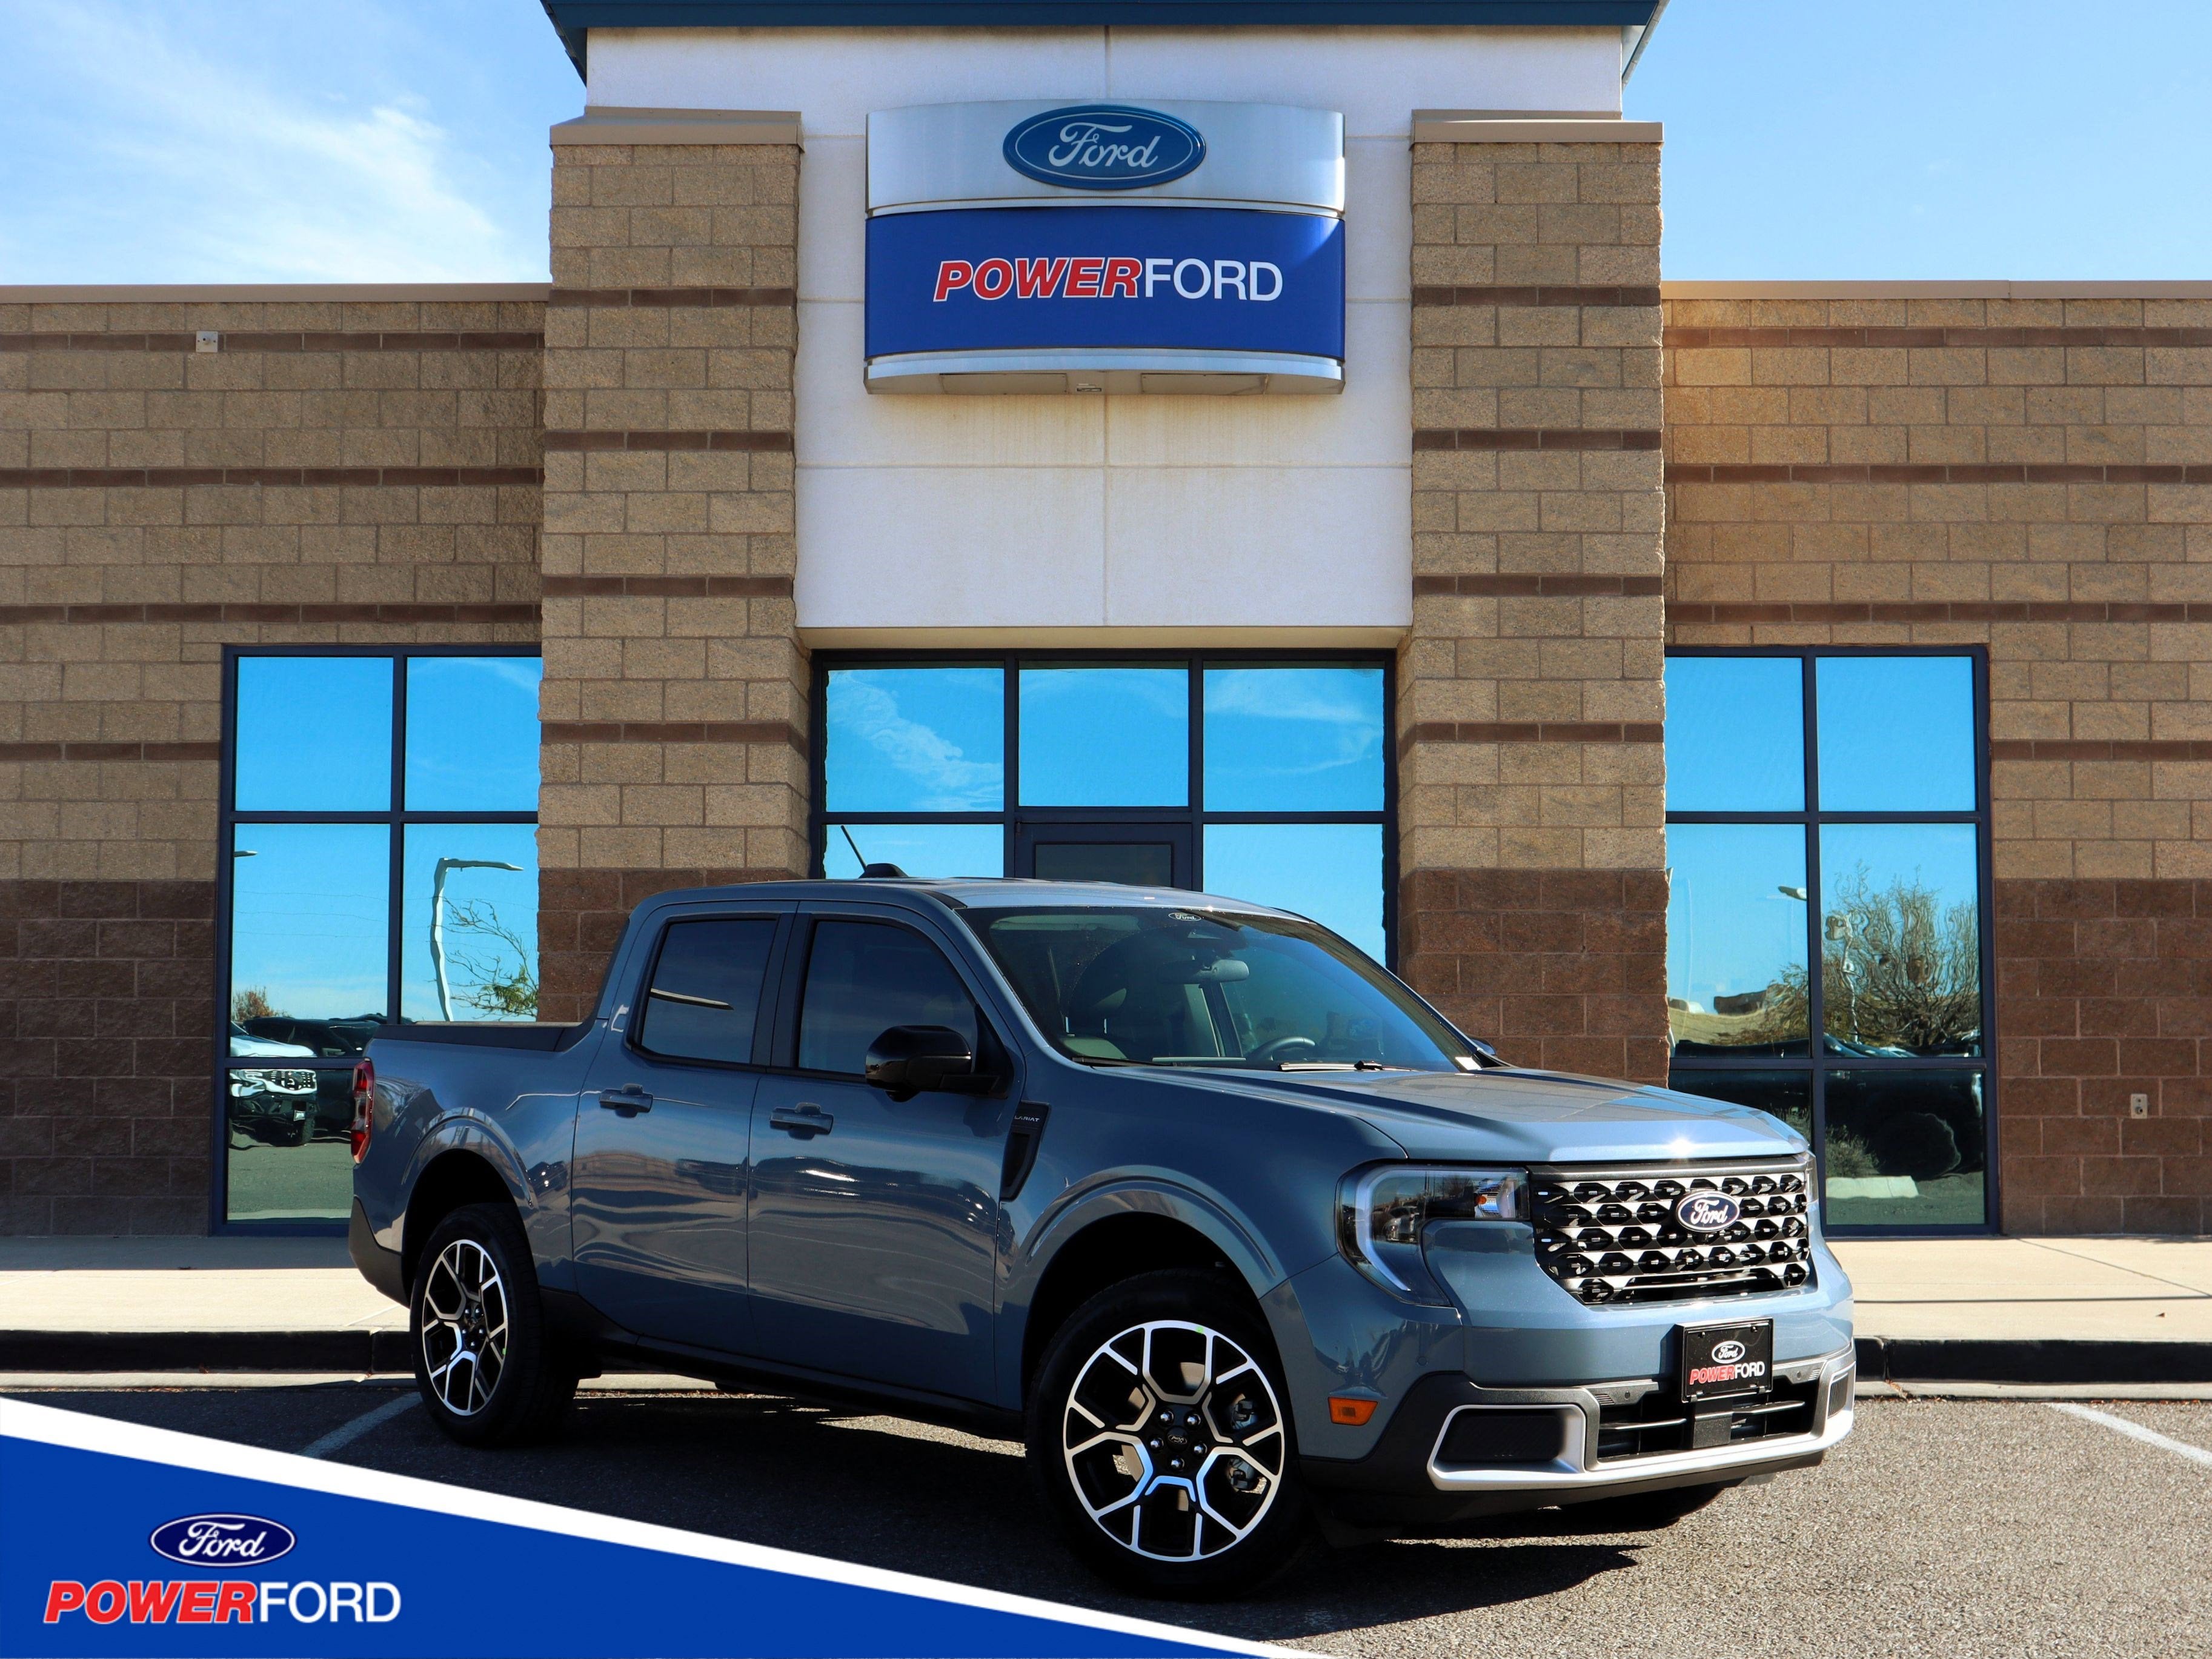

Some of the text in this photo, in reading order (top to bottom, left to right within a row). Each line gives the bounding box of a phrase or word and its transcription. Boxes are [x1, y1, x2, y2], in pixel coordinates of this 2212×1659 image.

[1048, 122, 1161, 168] Ford
[933, 257, 1283, 302] POWERFORD
[1690, 1199, 1729, 1225] Ford
[1718, 1345, 1739, 1358] Ford
[1689, 1361, 1765, 1385] POWERFORD
